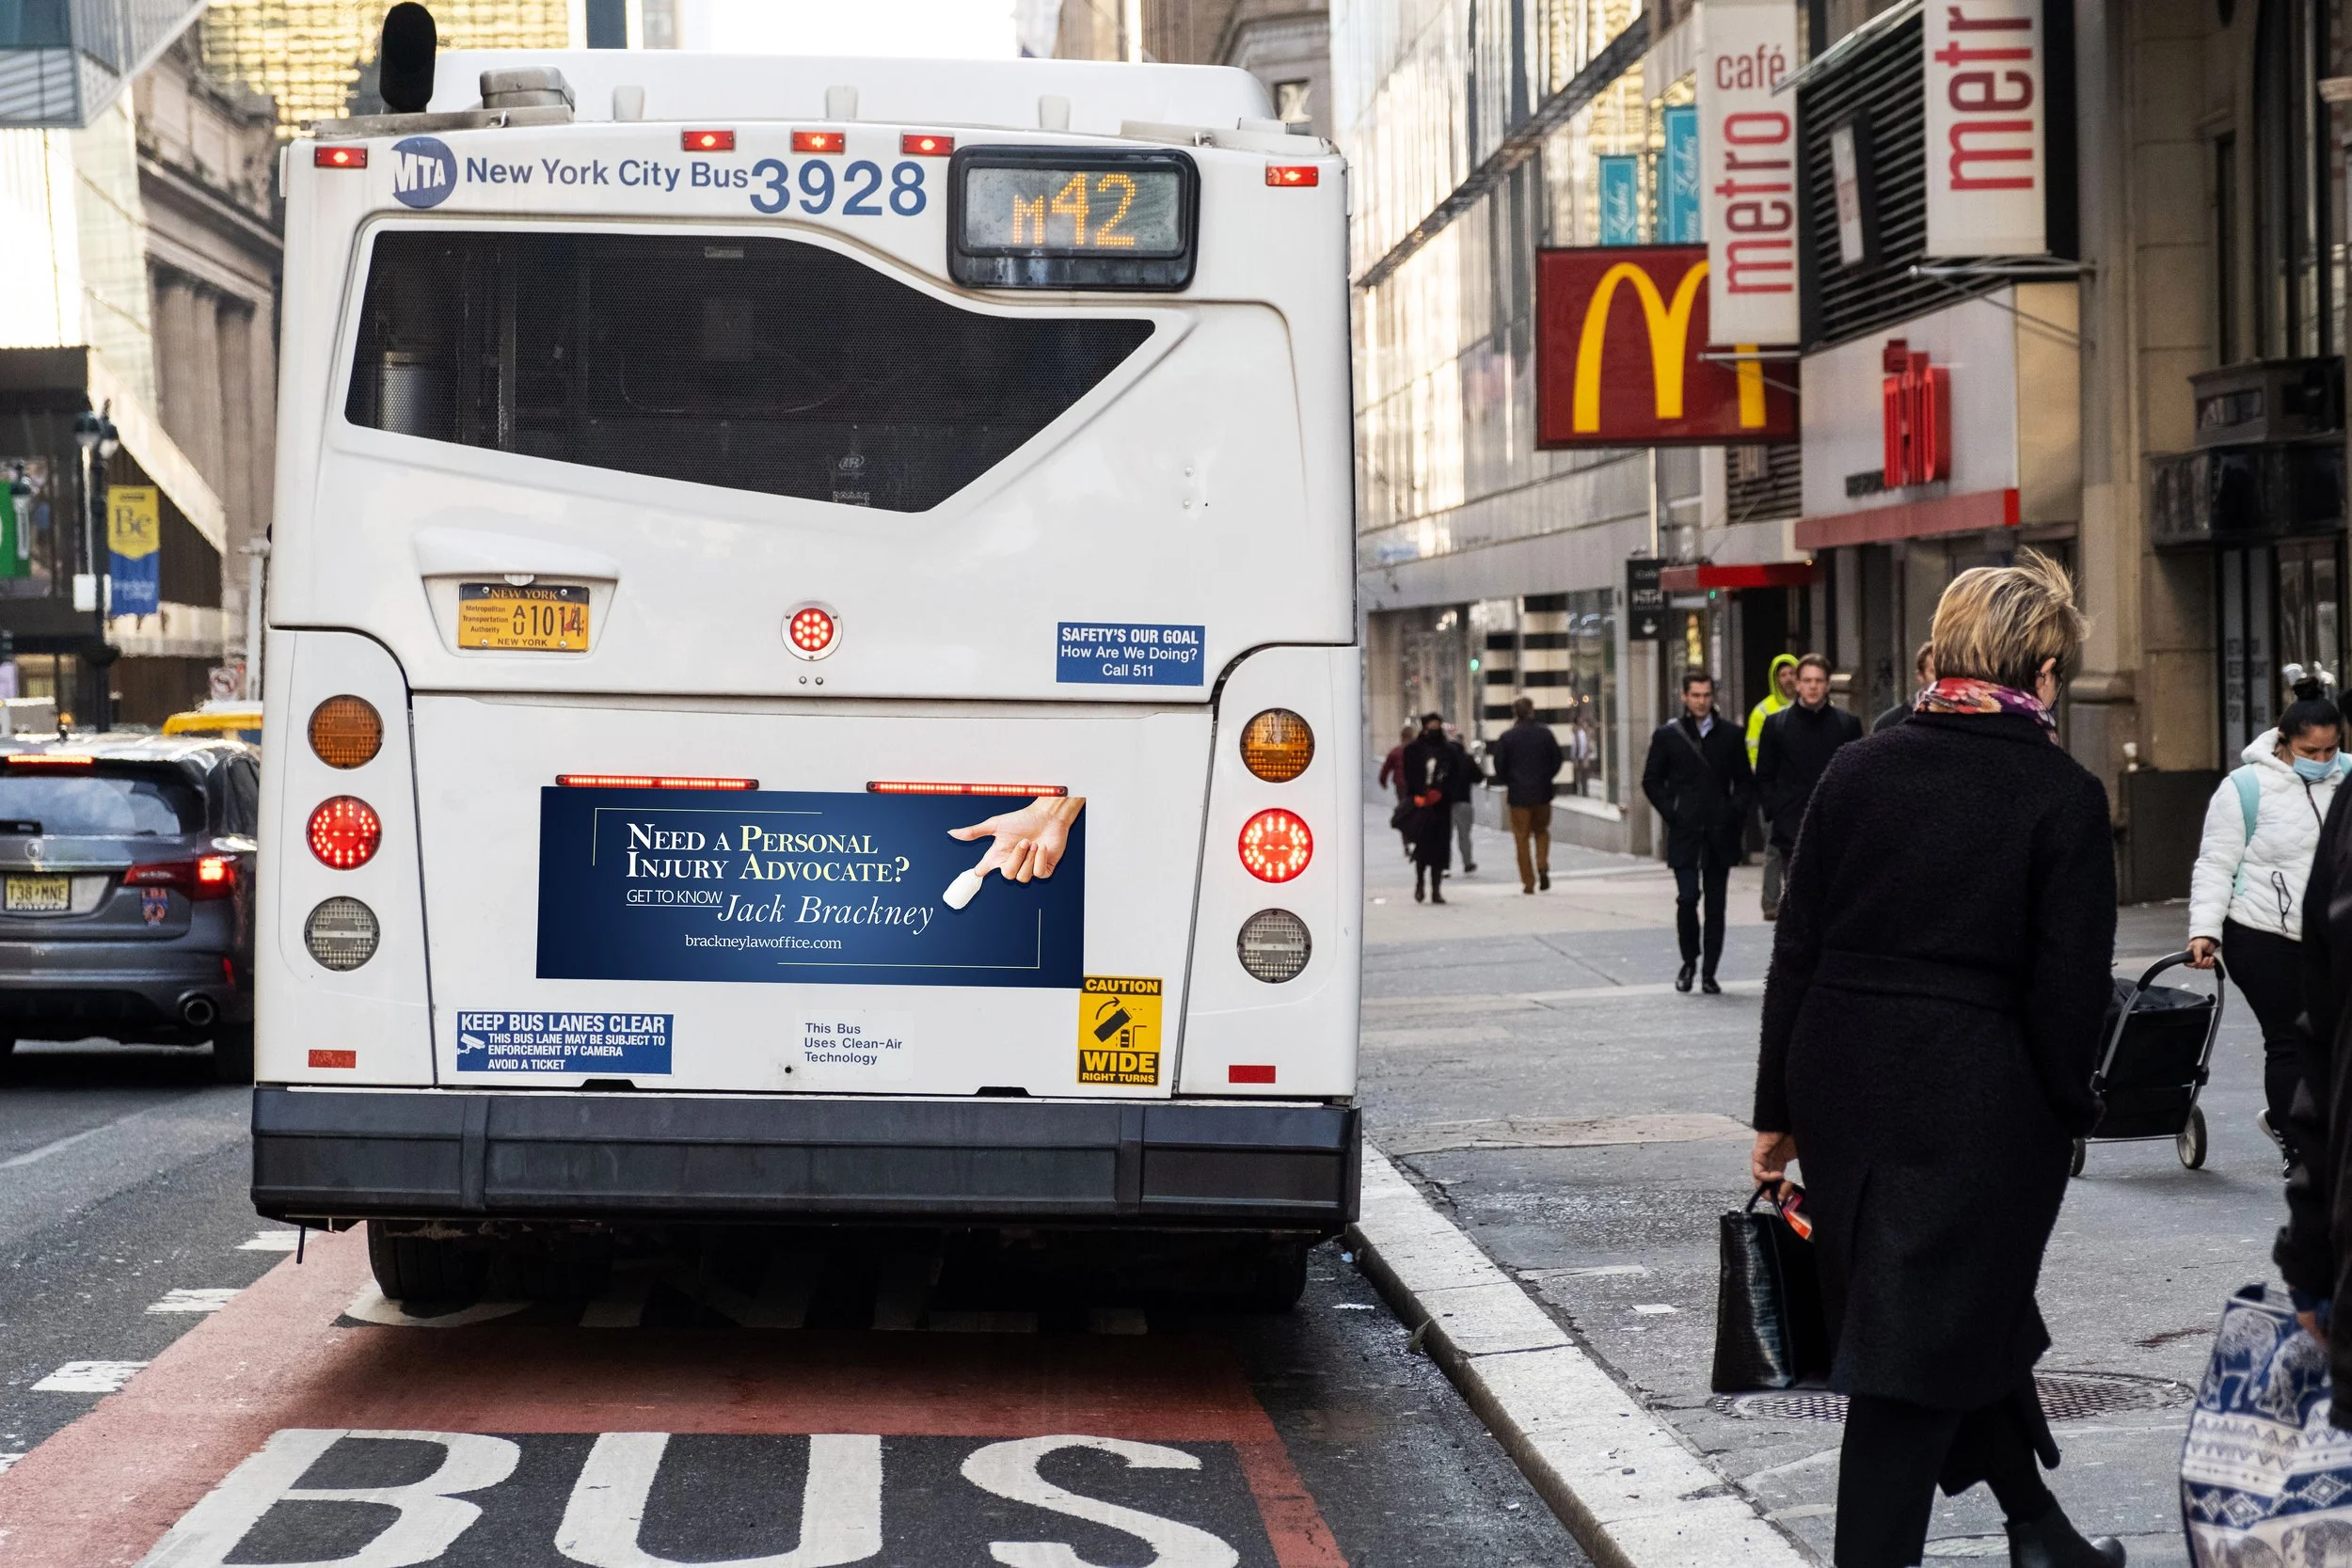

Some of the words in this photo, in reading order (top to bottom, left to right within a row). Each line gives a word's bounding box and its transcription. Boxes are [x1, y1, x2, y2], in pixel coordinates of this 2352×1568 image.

[1716, 44, 1786, 89] café
[392, 150, 446, 192] MTA
[466, 156, 532, 183] New
[542, 158, 609, 185] York
[618, 159, 680, 192] City
[691, 161, 749, 189] Bus
[750, 157, 927, 216] 3928
[1715, 111, 1792, 294] metro
[491, 588, 522, 599] NEW
[525, 589, 558, 600] YORK
[466, 605, 506, 613] Metropolitan
[531, 605, 581, 637] 1014
[470, 626, 500, 634] Authority
[1062, 627, 1126, 642] SAFETY'S
[1131, 629, 1159, 643] OUR
[1163, 630, 1200, 644] GOAL
[522, 639, 548, 647] YORK
[1061, 645, 1091, 657] How
[1096, 646, 1120, 658] Are
[1123, 646, 1145, 659] We
[1150, 647, 1198, 663] Doing?
[1103, 663, 1128, 676] Call
[1133, 664, 1153, 676] 511
[713, 832, 732, 851] A
[627, 889, 652, 904] GET
[655, 890, 674, 904] TO
[676, 891, 723, 904] KNOW
[717, 894, 785, 923] Jack
[794, 895, 934, 935] Brackney
[685, 935, 842, 950] brackneylawoffice.com
[1085, 979, 1158, 993] CAUTION
[461, 1014, 503, 1031] KEEP
[509, 1015, 544, 1031] BUS
[548, 1015, 604, 1032] LANES
[610, 1016, 664, 1033] CLEAR
[805, 1022, 831, 1034] This
[837, 1023, 861, 1034] Bus
[488, 1034, 511, 1043] THIS
[514, 1034, 533, 1044] BUS
[536, 1034, 562, 1044] LANE
[564, 1035, 586, 1044] MAY
[590, 1035, 602, 1045] BE
[605, 1035, 649, 1045] SUBJECT
[653, 1036, 665, 1046] TO
[804, 1037, 836, 1048] Uses
[842, 1037, 902, 1049] Clean-Air
[488, 1045, 562, 1055] ENFORCEMENT
[564, 1046, 578, 1056] BY
[580, 1046, 623, 1056] CAMERA
[487, 1059, 518, 1069] AVOID
[521, 1059, 529, 1069] A
[531, 1059, 565, 1070] TICKET
[804, 1052, 878, 1065] Technology
[1083, 1052, 1155, 1072] WIDE
[1082, 1072, 1116, 1082] RIGHT
[1119, 1073, 1154, 1083] TURNS
[132, 1428, 1240, 1568] BUS
